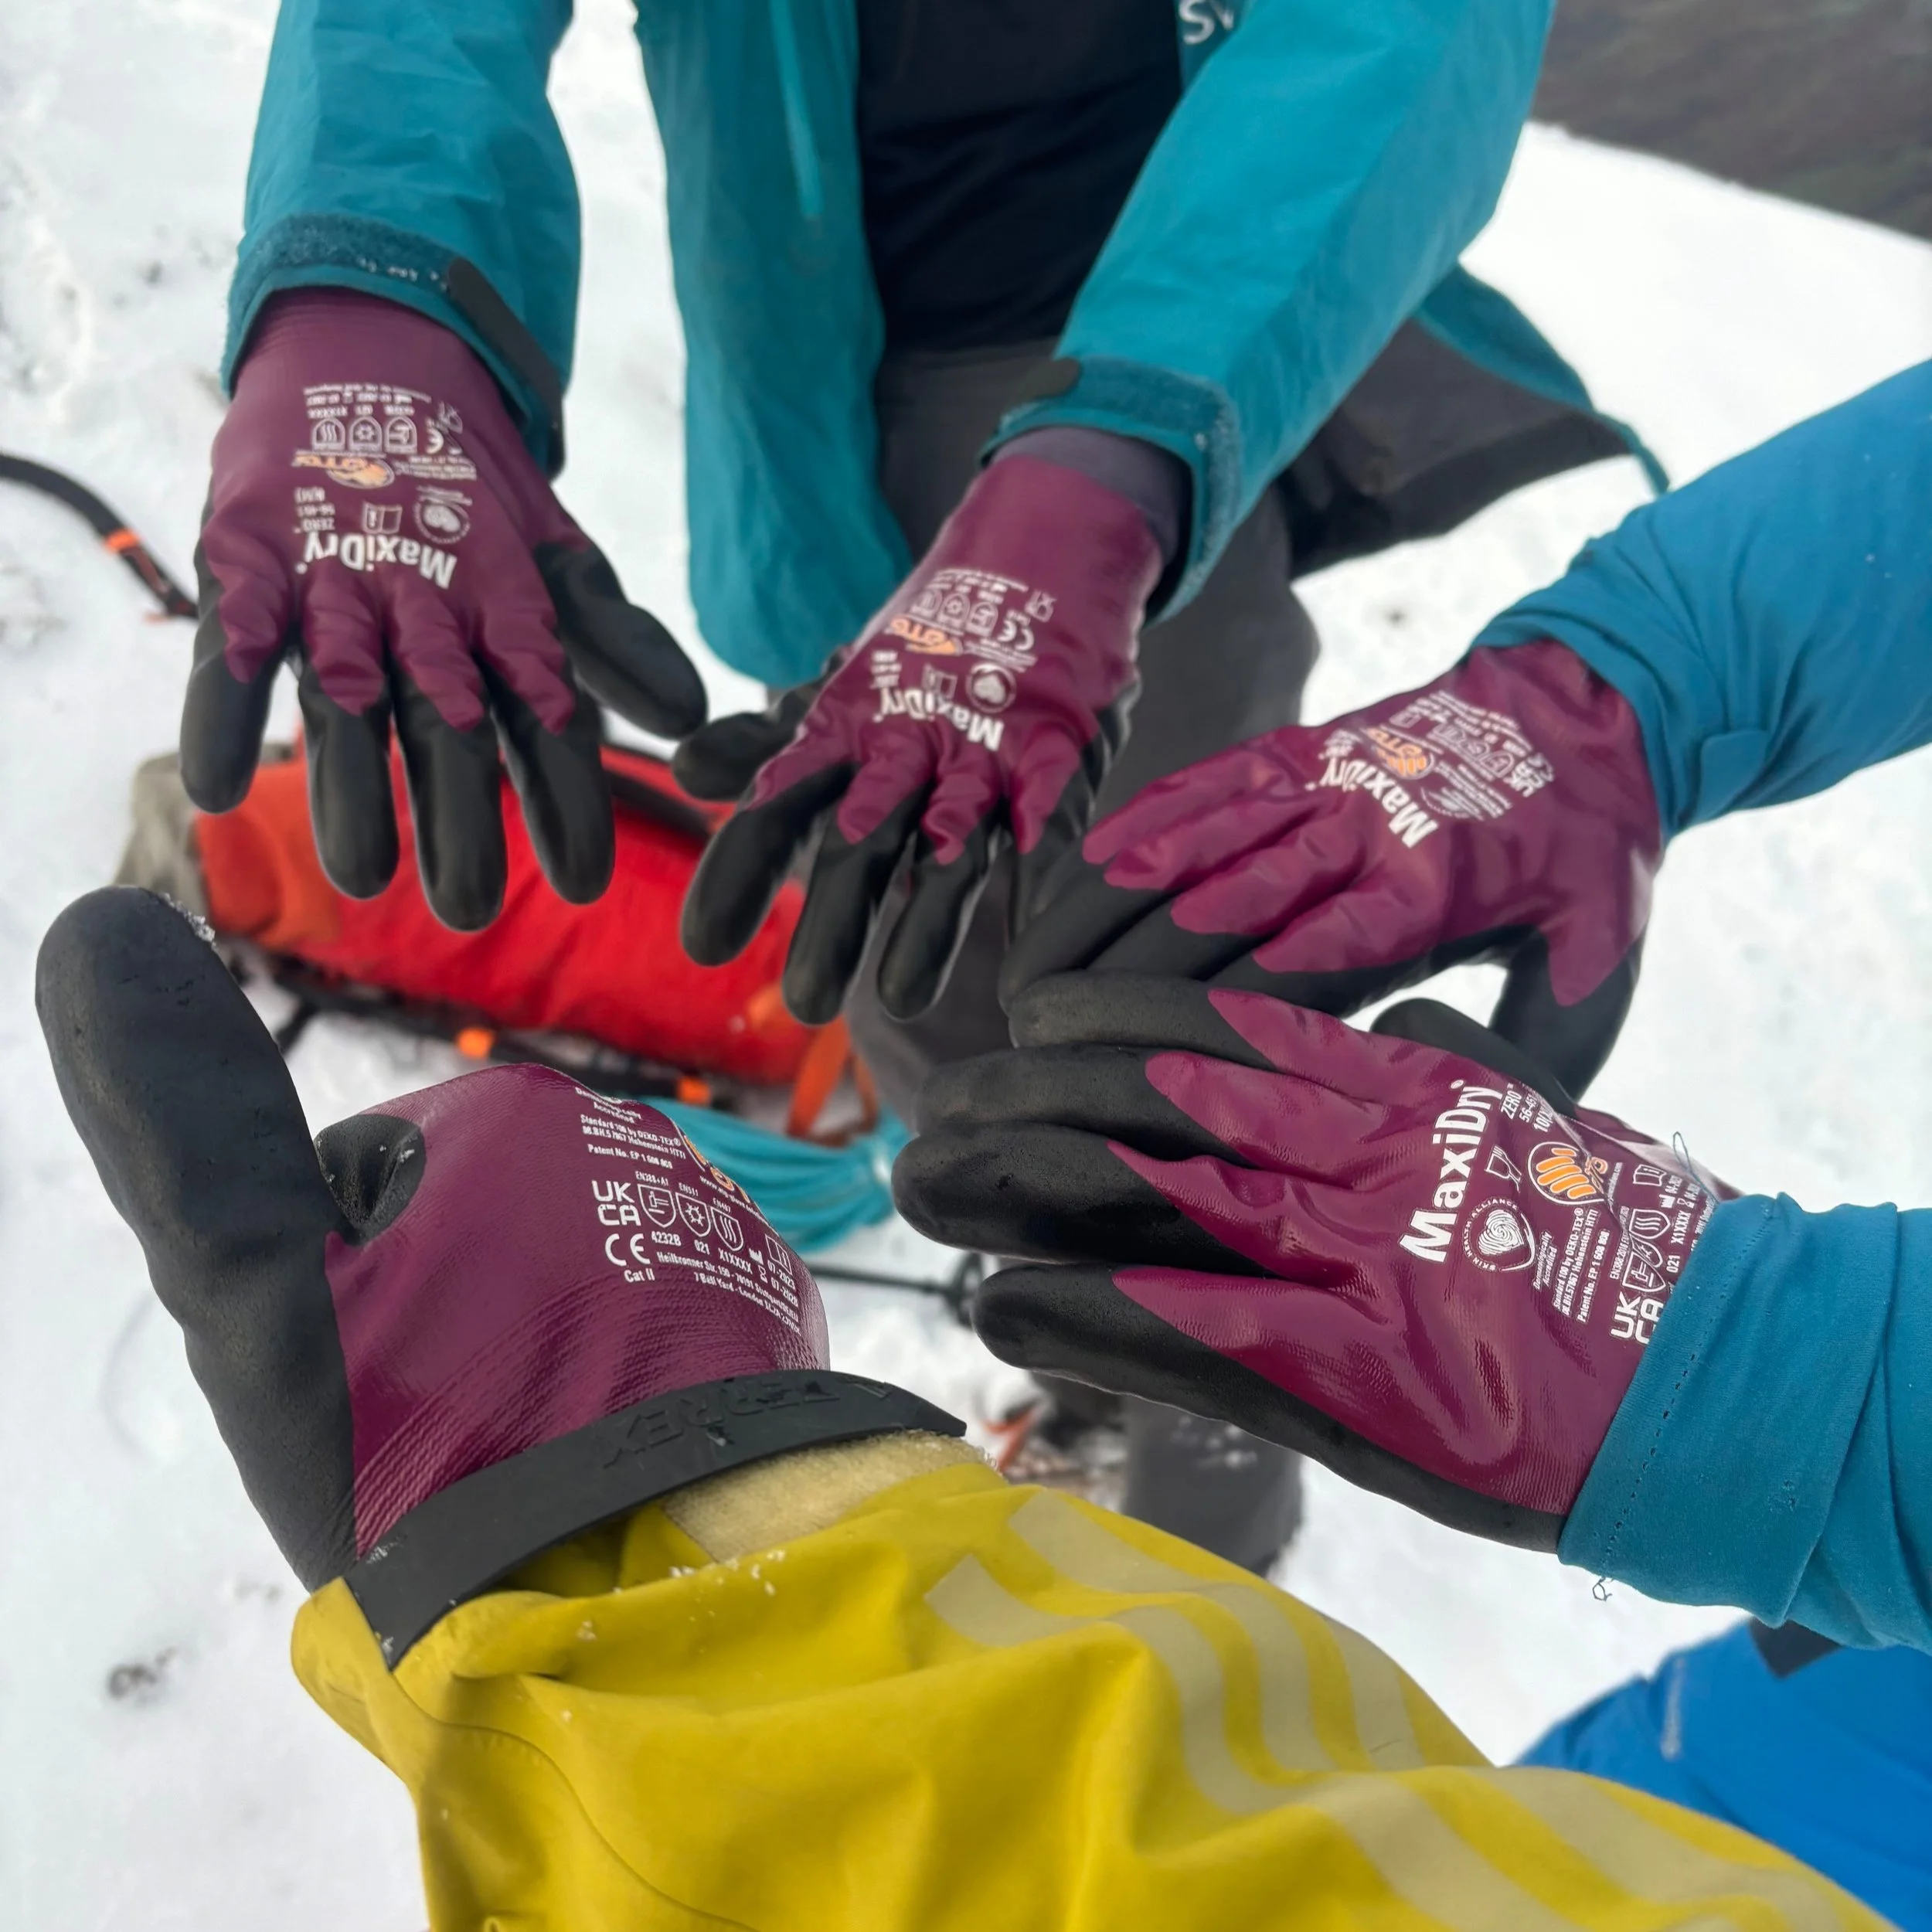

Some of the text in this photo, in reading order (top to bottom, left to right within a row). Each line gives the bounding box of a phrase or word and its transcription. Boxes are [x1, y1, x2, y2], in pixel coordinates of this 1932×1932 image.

[1501, 1090, 1522, 1120] ZERO
[1519, 1093, 1538, 1123] 56-451
[580, 1114, 614, 1130] Standard
[627, 1127, 638, 1138] by
[587, 1144, 614, 1156] Patent
[614, 1148, 630, 1159] No.
[630, 1151, 641, 1161] EP
[628, 1136, 670, 1154] Hohenstein
[591, 1180, 635, 1203] UK
[597, 1203, 642, 1226] CA
[1670, 1209, 1692, 1245] X1XXXX
[1462, 1198, 1519, 1271] SKIN HEALTH ALLIANCE
[604, 1233, 651, 1267] CE
[651, 1230, 753, 1275] 4232B 021 X1XXXX
[657, 1251, 705, 1270] Heilbronner
[718, 1265, 731, 1278] 150
[1533, 1231, 1553, 1291] Dermatologically
[1562, 1257, 1573, 1267] by
[1572, 1227, 1592, 1274] Hohenstein
[1666, 1254, 1681, 1274] 021
[623, 1267, 655, 1284] Cat II
[1542, 1246, 1557, 1287] Accredited
[1559, 1266, 1569, 1279] 100
[1588, 1267, 1599, 1280] EP
[716, 1276, 735, 1292] Yard
[739, 1286, 764, 1307] London
[1553, 1273, 1565, 1311] Standard
[1583, 1277, 1597, 1293] No.
[1577, 1288, 1592, 1322] Patent
[1610, 1291, 1641, 1338] UK
